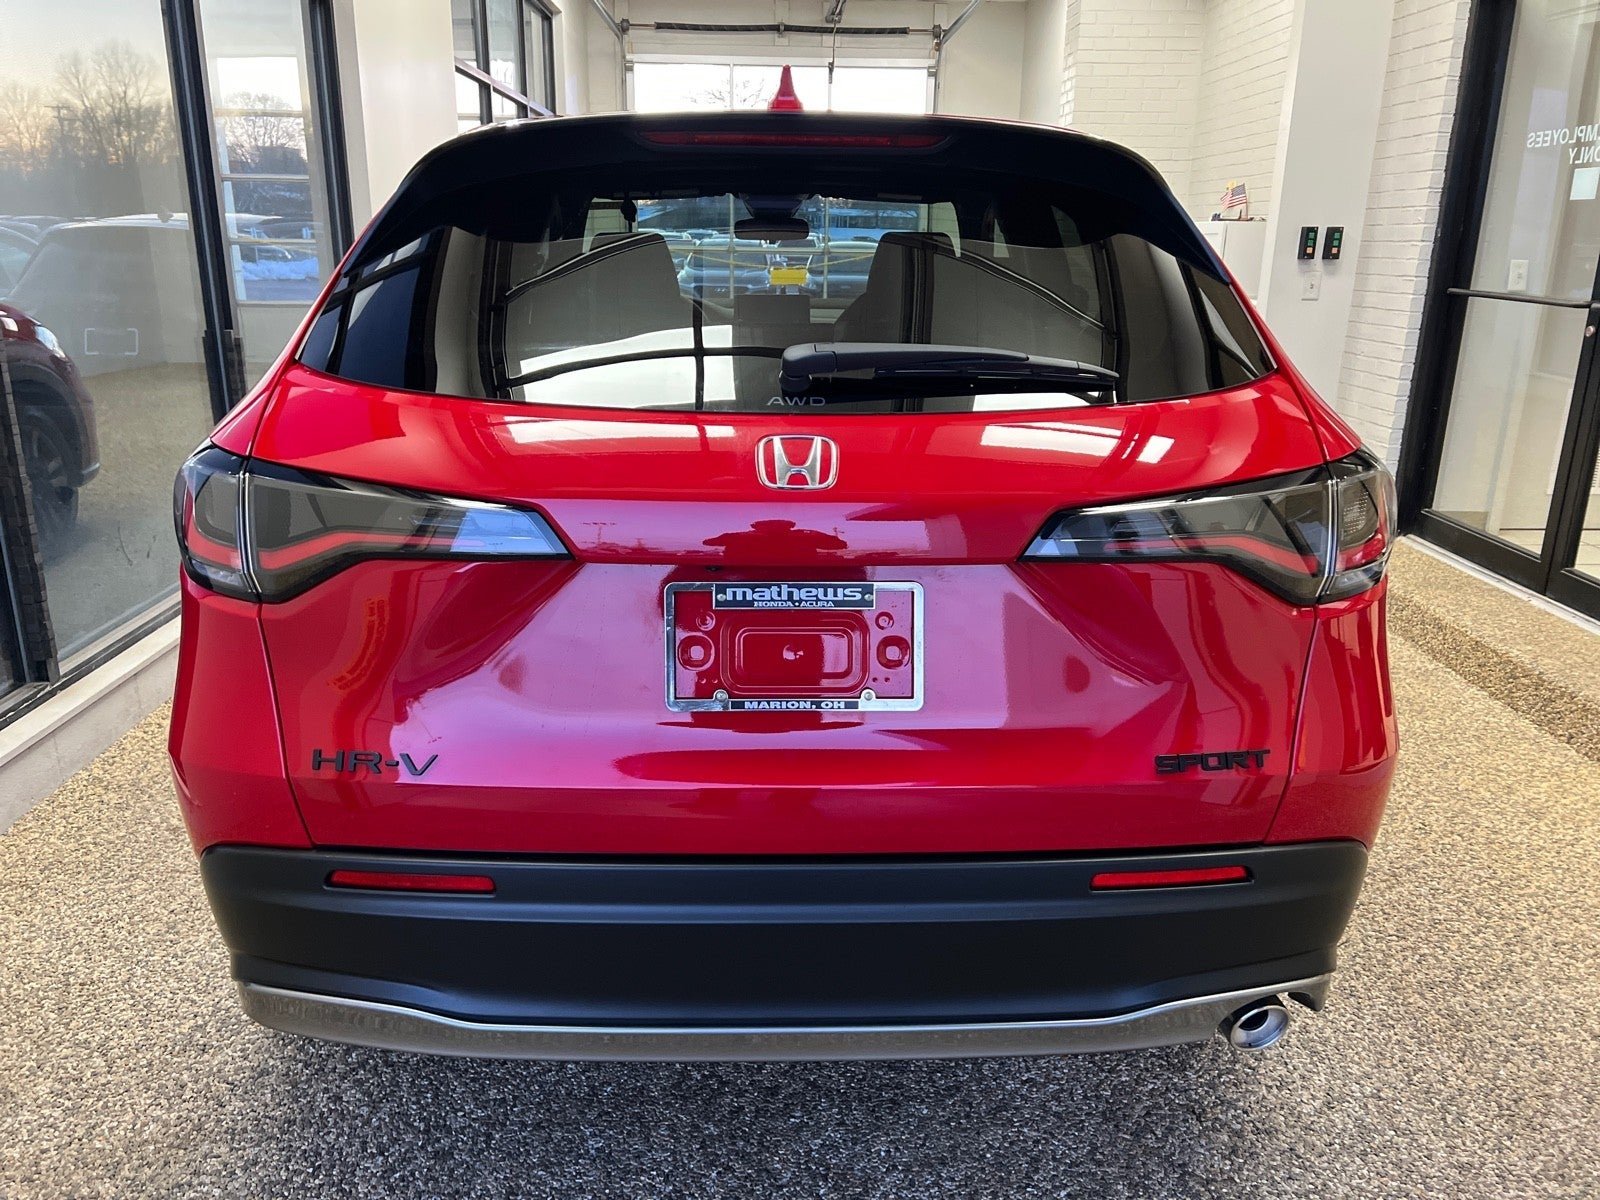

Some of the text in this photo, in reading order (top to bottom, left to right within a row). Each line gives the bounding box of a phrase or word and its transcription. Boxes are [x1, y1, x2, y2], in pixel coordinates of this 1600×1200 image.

[766, 396, 826, 406] AWD
[726, 584, 862, 601] mathews
[744, 701, 845, 709] MARION, OH
[312, 749, 438, 776] HR-V
[1155, 749, 1271, 774] SPORT
